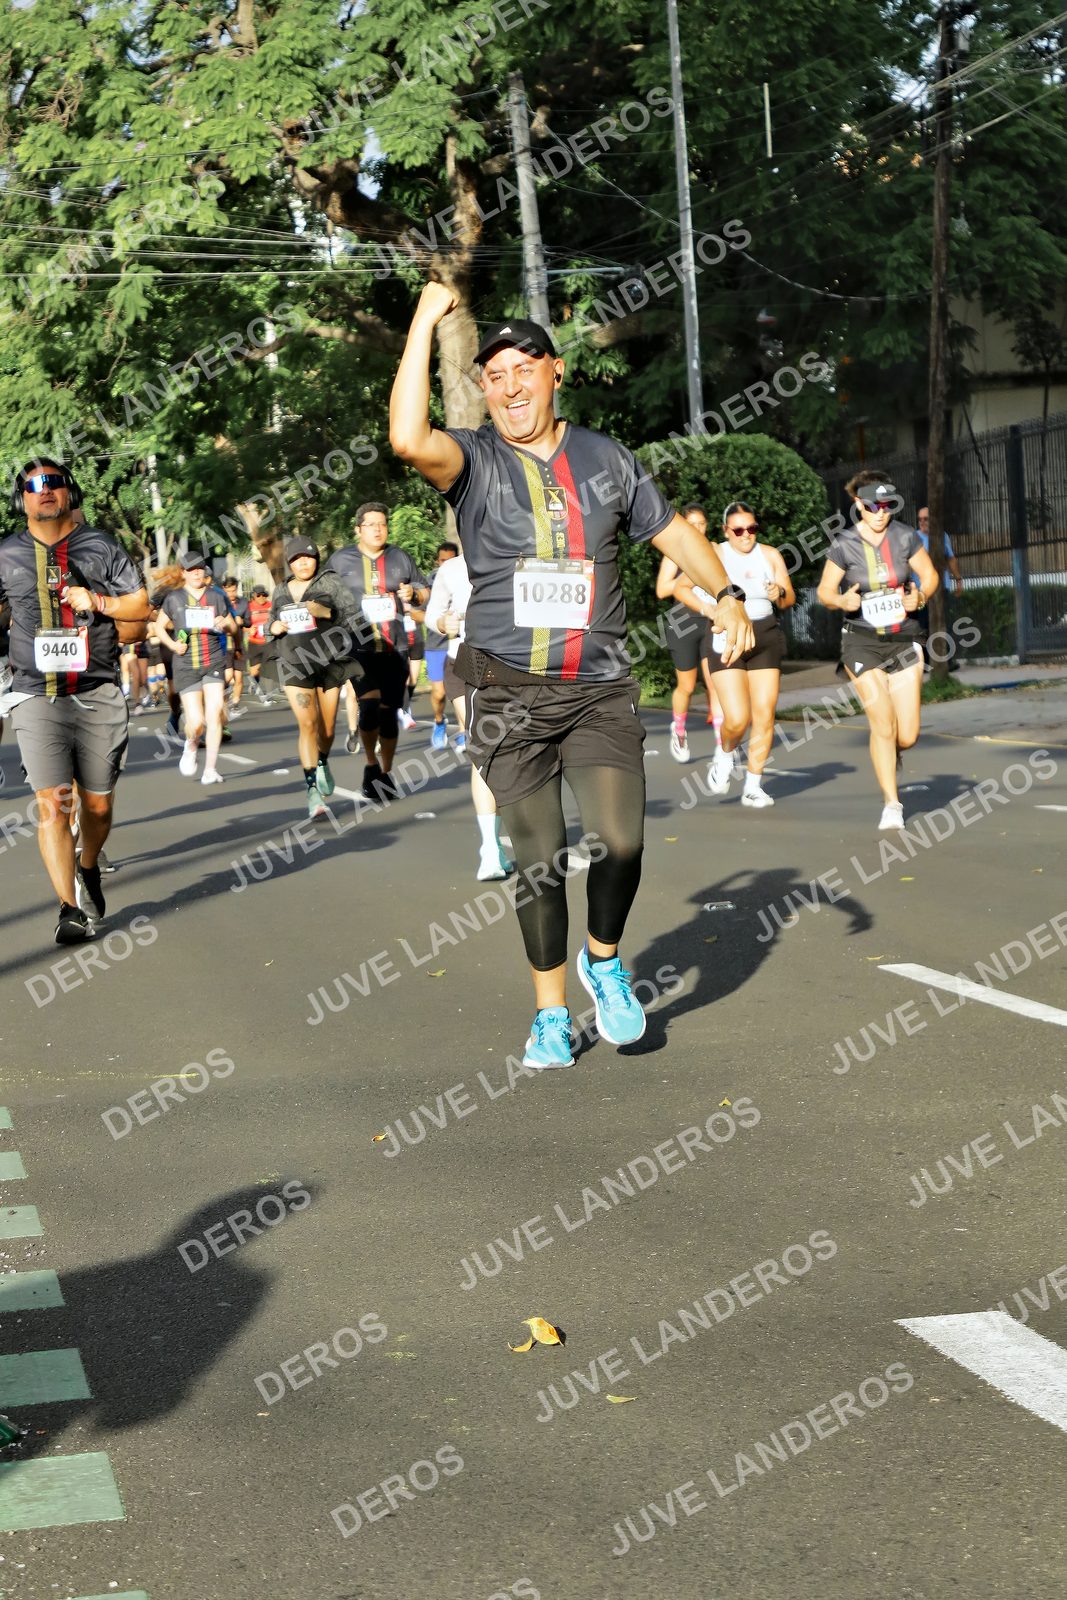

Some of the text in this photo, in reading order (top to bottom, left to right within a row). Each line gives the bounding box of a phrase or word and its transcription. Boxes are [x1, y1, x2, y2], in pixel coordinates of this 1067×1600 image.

[519, 581, 587, 605] 10288
[866, 599, 901, 615] 11438
[42, 642, 78, 657] 9440
